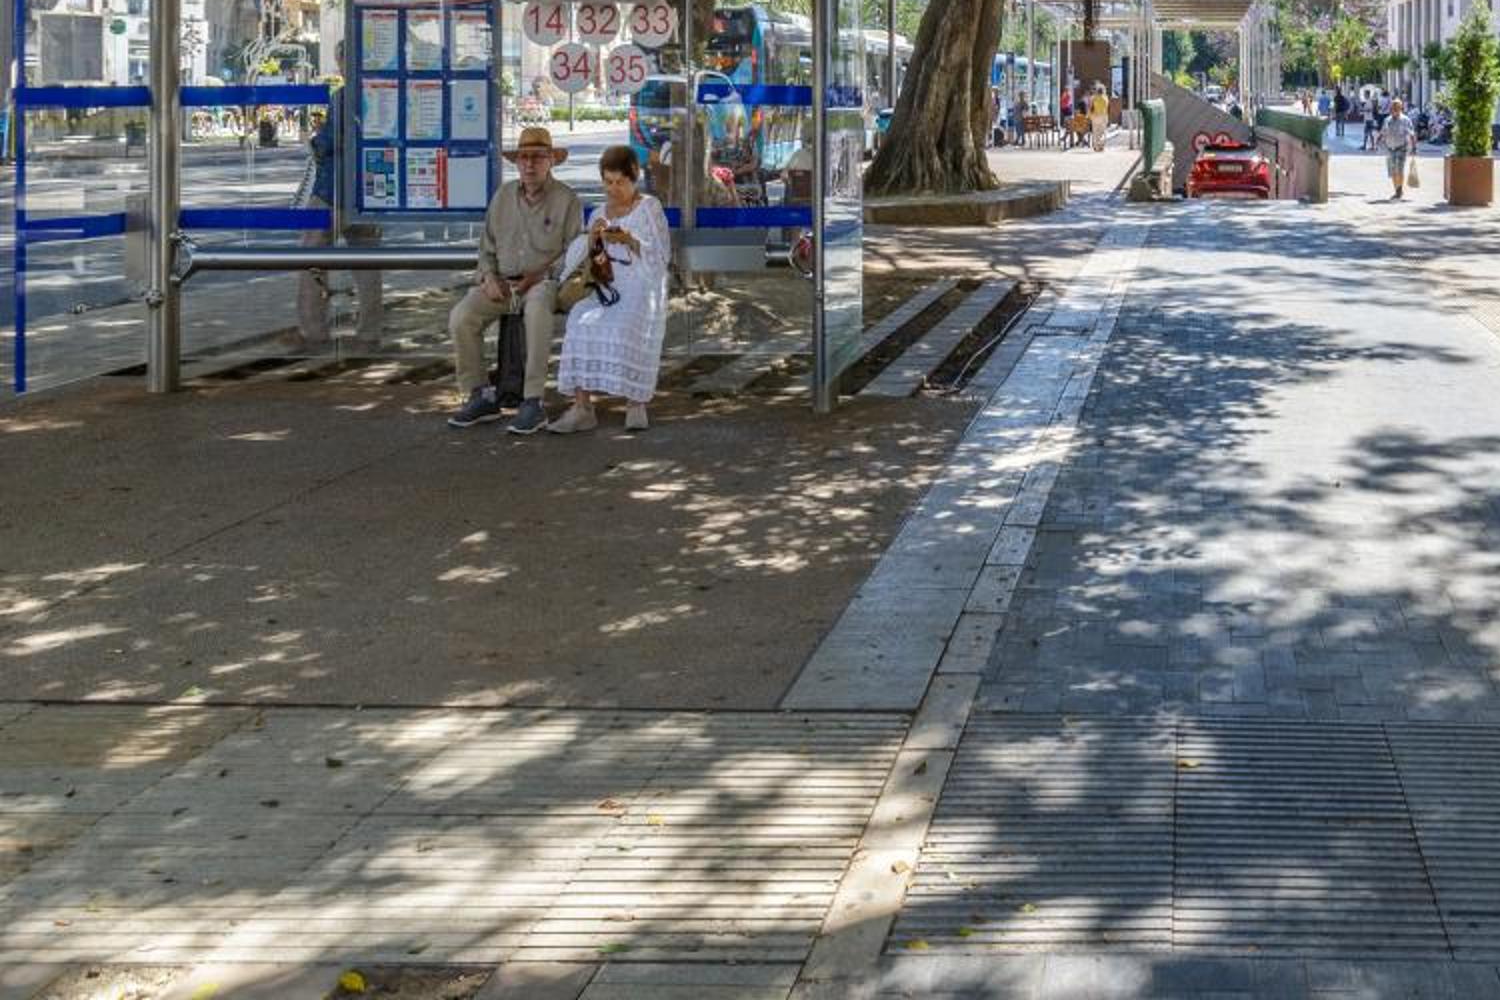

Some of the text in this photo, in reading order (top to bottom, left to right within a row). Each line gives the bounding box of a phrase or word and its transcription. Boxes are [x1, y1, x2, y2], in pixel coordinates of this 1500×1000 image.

[528, 5, 564, 35] 14
[578, 4, 617, 35] 32
[632, 4, 670, 35] 33
[552, 51, 592, 81] 34
[609, 55, 646, 83] 35
